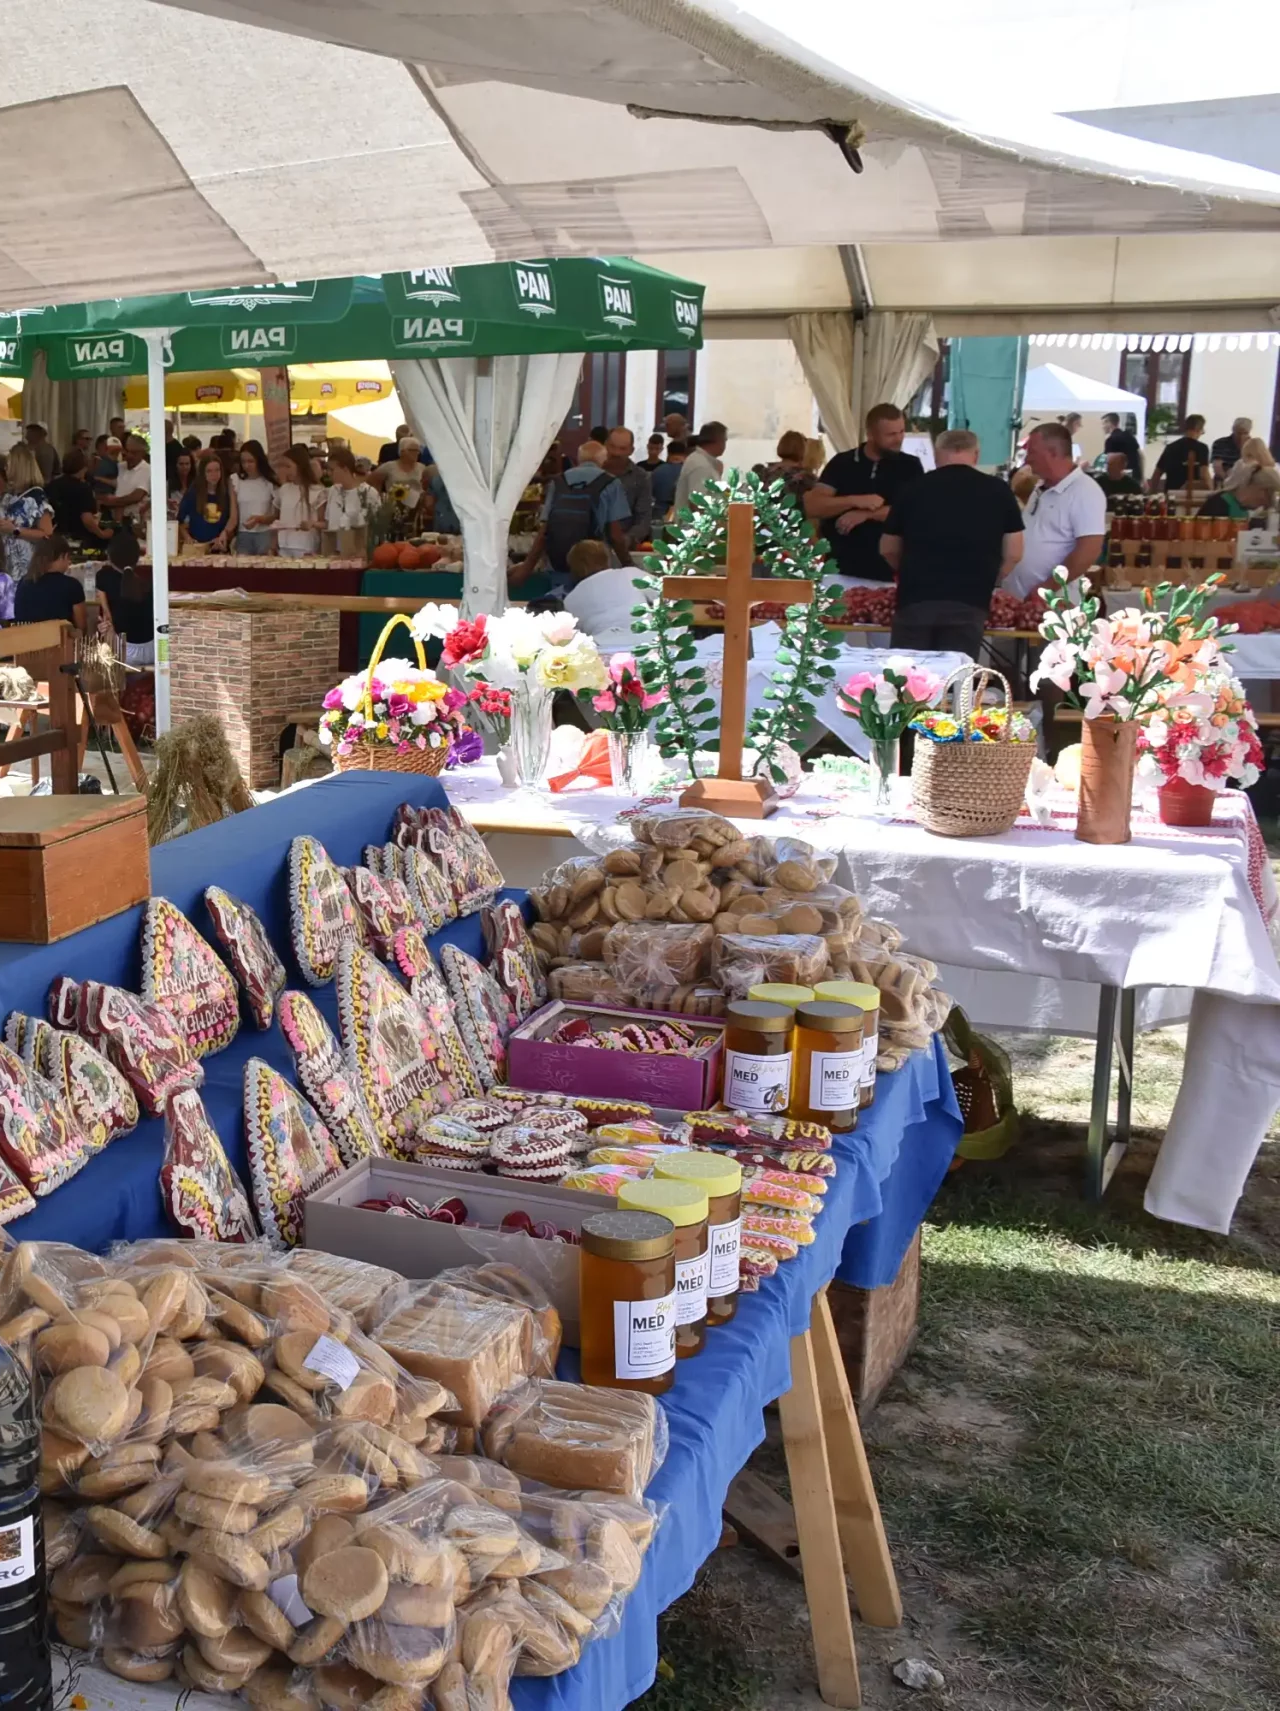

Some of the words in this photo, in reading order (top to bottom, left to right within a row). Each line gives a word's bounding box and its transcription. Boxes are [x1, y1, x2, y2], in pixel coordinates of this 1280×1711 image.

[516, 269, 551, 301] PAN
[603, 285, 632, 315] PAN
[675, 300, 699, 327] PAN
[733, 1069, 759, 1082] MED
[824, 1070, 850, 1080] MED
[714, 1240, 738, 1255] MED
[677, 1275, 704, 1292] MED
[633, 1315, 665, 1330] MED
